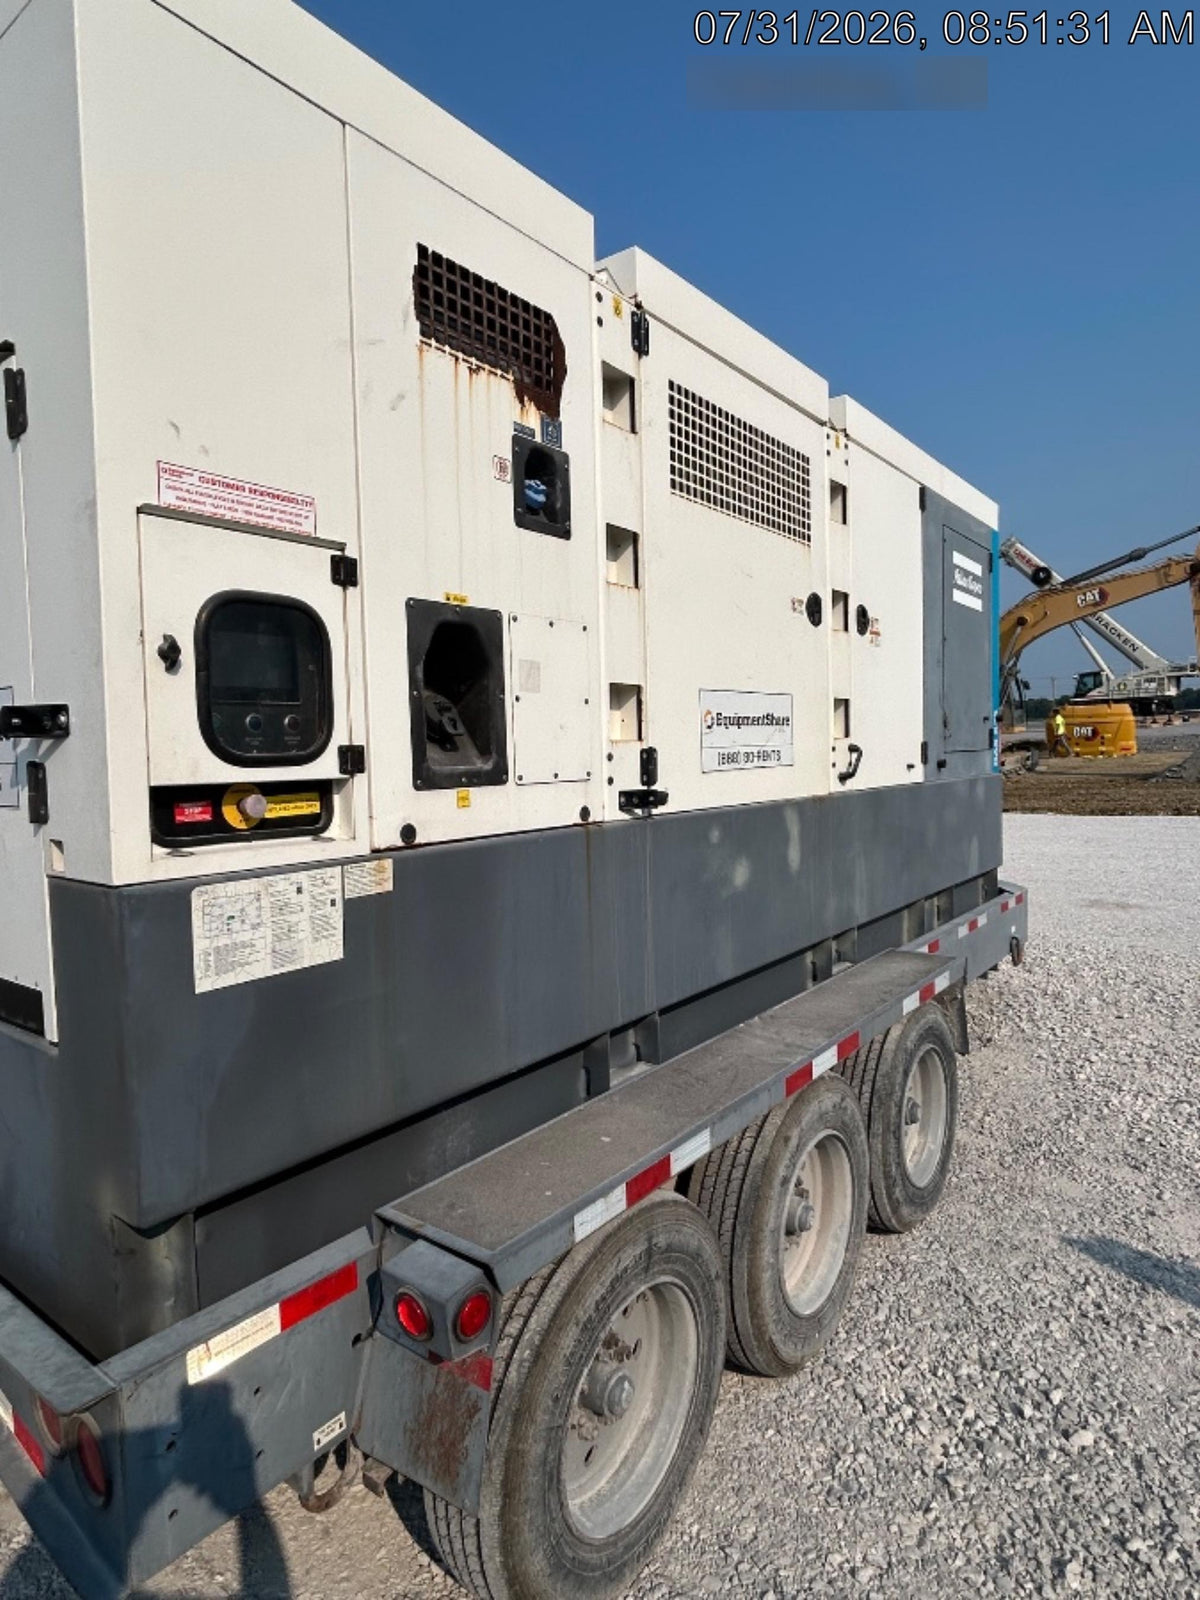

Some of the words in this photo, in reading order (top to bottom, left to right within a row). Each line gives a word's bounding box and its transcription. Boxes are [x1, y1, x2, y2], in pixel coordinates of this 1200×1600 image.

[1077, 588, 1099, 607] CAT
[1092, 613, 1139, 653] RACKEN
[716, 712, 790, 729] EquipmentShare
[1073, 726, 1093, 738] CAT
